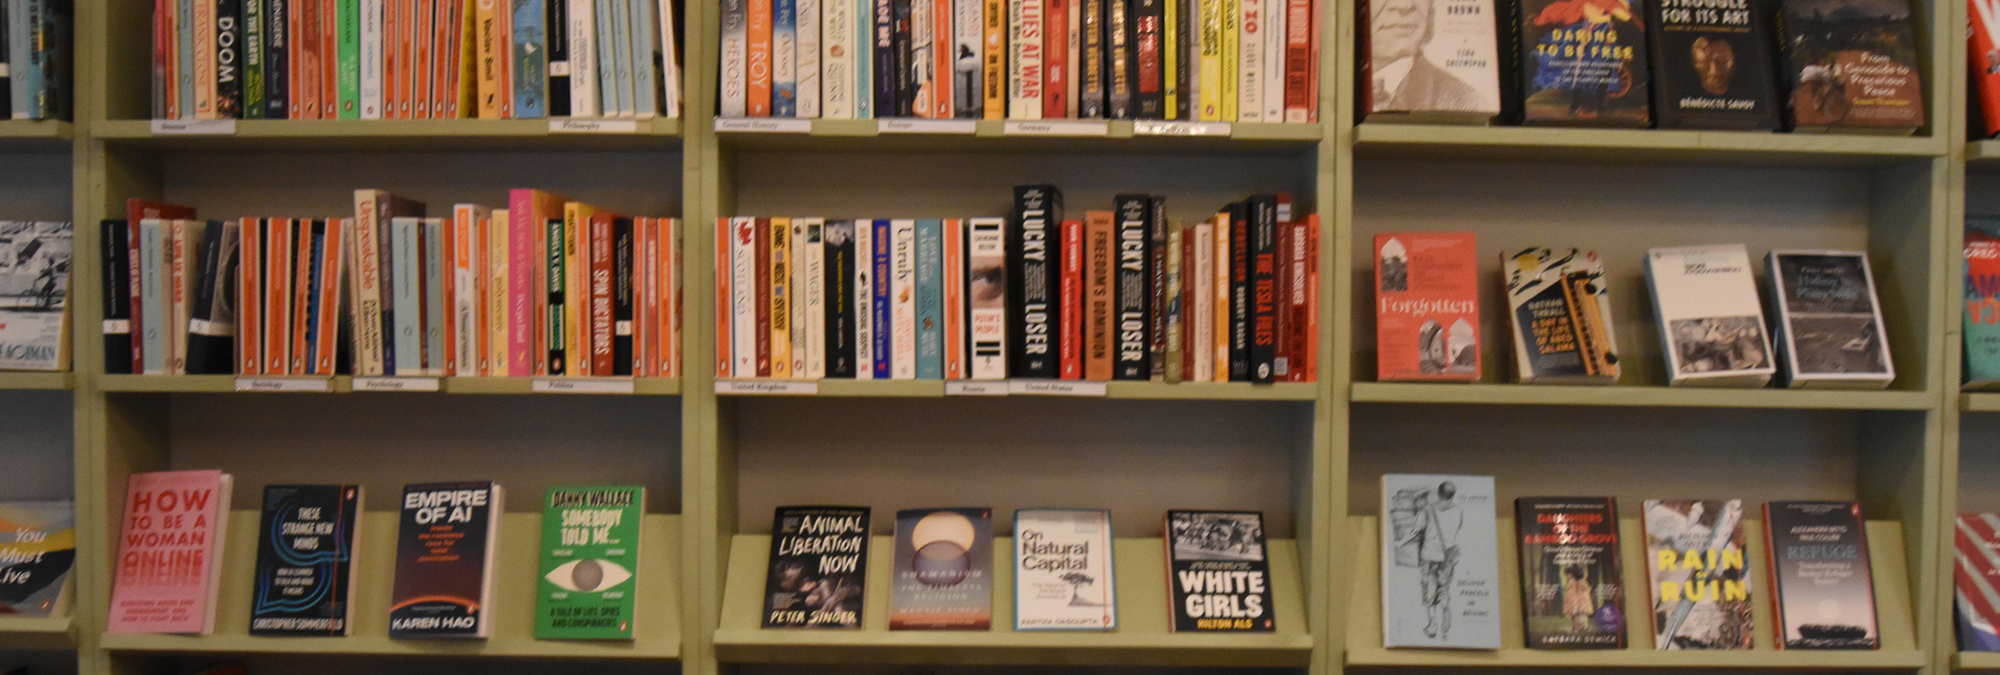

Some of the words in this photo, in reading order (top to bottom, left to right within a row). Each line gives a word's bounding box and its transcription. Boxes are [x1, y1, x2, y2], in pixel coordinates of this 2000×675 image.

[1446, 6, 1482, 16] BROWN
[1661, 9, 1691, 24] FOR
[1695, 9, 1719, 25] ITS
[1722, 9, 1750, 25] ART
[1551, 28, 1618, 43] DARING
[218, 16, 235, 83] DOOM
[1021, 44, 1040, 60] AT
[1536, 44, 1558, 58] TO
[1563, 44, 1584, 59] BE
[1590, 44, 1634, 61] FREE
[726, 38, 742, 98] HEROES
[750, 40, 768, 89] TROY
[1021, 65, 1040, 100] WAR
[357, 199, 378, 292] Unspeakable
[1022, 208, 1047, 262] LUCKY
[1120, 218, 1145, 272] LUCKY
[895, 226, 913, 284] Unruly
[1235, 219, 1247, 283] REBELLION
[1092, 230, 1109, 297] FREEDOM'S
[1256, 253, 1274, 276] THE
[593, 269, 610, 296] SPIN
[1256, 280, 1274, 314] TESLA
[1380, 296, 1476, 318] Forgotten
[593, 297, 610, 356] DICTATORS
[1024, 302, 1049, 355] LOSER
[1092, 300, 1108, 360] DOMINION
[1120, 310, 1145, 362] LOSER
[1255, 316, 1274, 347] FILES
[132, 487, 212, 514] HOW
[403, 488, 490, 510] EMPIRE
[551, 489, 587, 509] DANNY
[586, 489, 635, 508] WALLACE
[130, 515, 153, 531] TO
[162, 514, 184, 530] BE
[193, 513, 206, 530] A
[297, 505, 323, 522] THESE
[414, 506, 448, 525] OF
[447, 506, 474, 525] AI
[561, 508, 624, 529] SOMEBODY
[1536, 512, 1605, 526] DAUGHTERS
[16, 526, 48, 544] You
[315, 520, 337, 537] NEW
[798, 513, 865, 537] ANIMAL
[1020, 528, 1044, 543] On
[127, 531, 206, 548] WOMAN
[292, 536, 320, 551] MINDS
[561, 526, 590, 547] TOLD
[778, 534, 864, 557] LIBERATION
[1524, 533, 1577, 546] BAMBOO
[0, 546, 46, 565] Must
[1021, 540, 1090, 556] Natural
[1786, 544, 1859, 562] REFUGE
[122, 549, 205, 576] ONLINE
[818, 552, 860, 577] NOW
[1021, 555, 1088, 575] Capital
[1656, 547, 1745, 572] RAIN
[1177, 569, 1266, 595] WHITE
[1659, 578, 1748, 604] RUIN
[769, 609, 807, 625] PETER
[807, 609, 858, 625] SINGER
[1184, 593, 1265, 620] GIRLS
[390, 616, 441, 632] KAREN
[440, 615, 476, 630] HAO
[1196, 618, 1233, 631] HILTON
[1233, 618, 1255, 631] ALS
[1541, 632, 1583, 645] BARBARA
